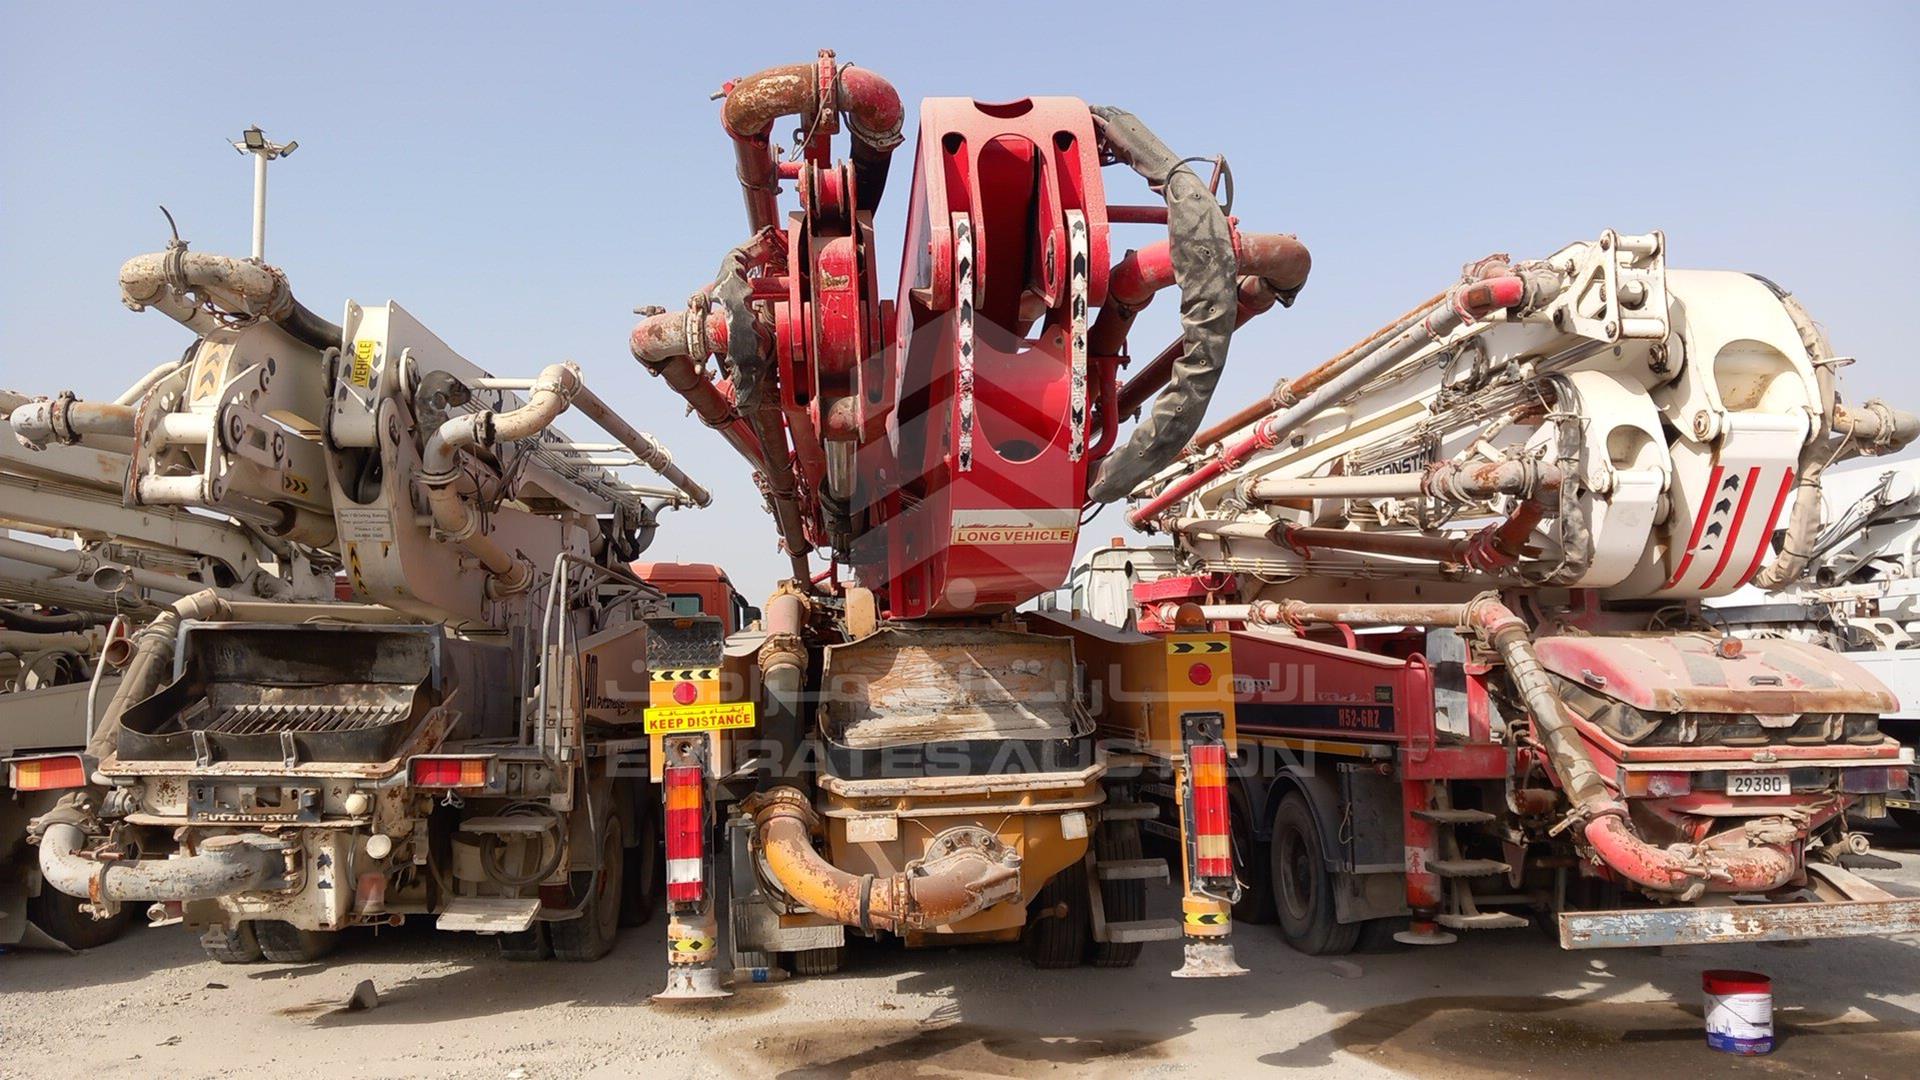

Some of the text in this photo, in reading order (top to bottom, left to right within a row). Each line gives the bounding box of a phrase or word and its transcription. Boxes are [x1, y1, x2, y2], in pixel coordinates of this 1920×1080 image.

[354, 343, 372, 383] VEHICLE
[957, 530, 1070, 542] LONG VEHICLE
[649, 713, 751, 730] KEEP DISTANCE
[1735, 776, 1782, 793] 29380
